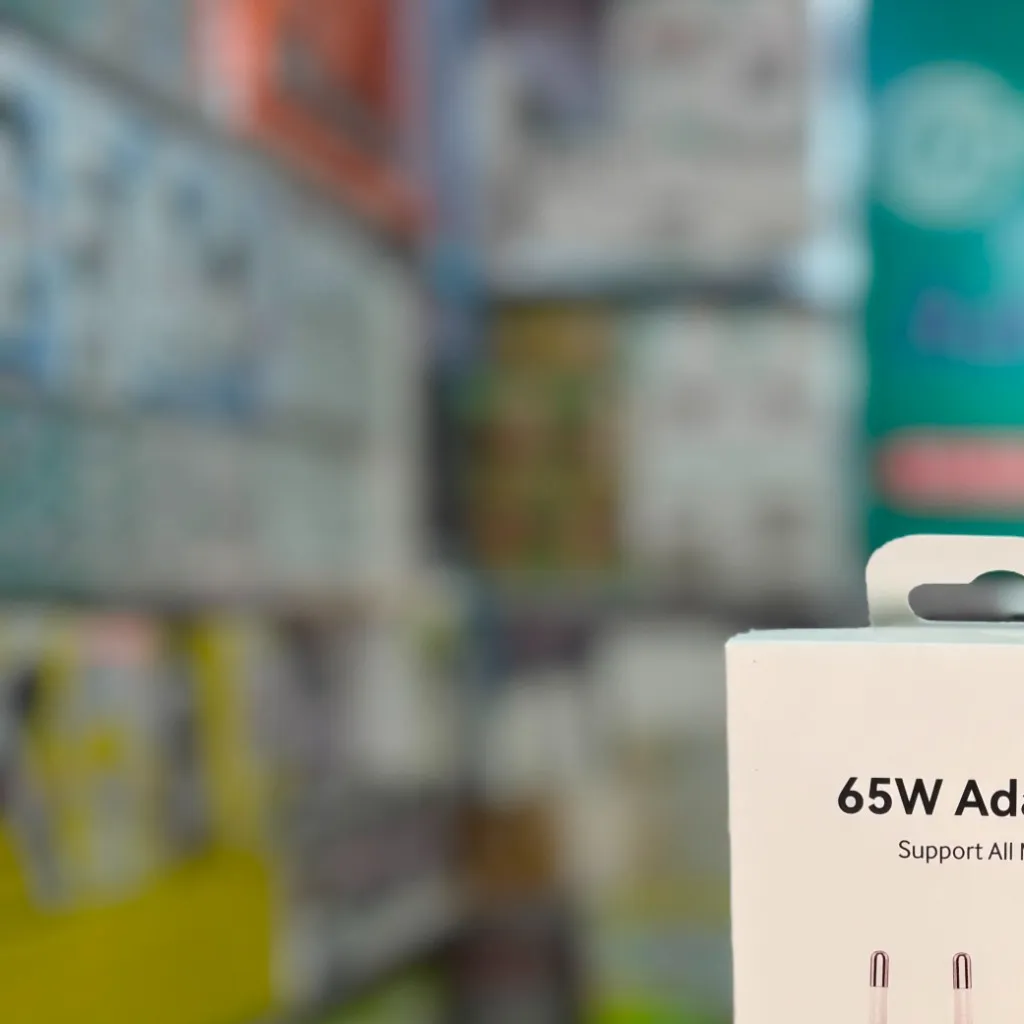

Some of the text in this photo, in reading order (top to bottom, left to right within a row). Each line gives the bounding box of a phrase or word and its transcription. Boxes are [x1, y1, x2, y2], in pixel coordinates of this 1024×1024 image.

[837, 776, 944, 816] 65W
[898, 839, 983, 865] Support
[988, 841, 1013, 861] All
